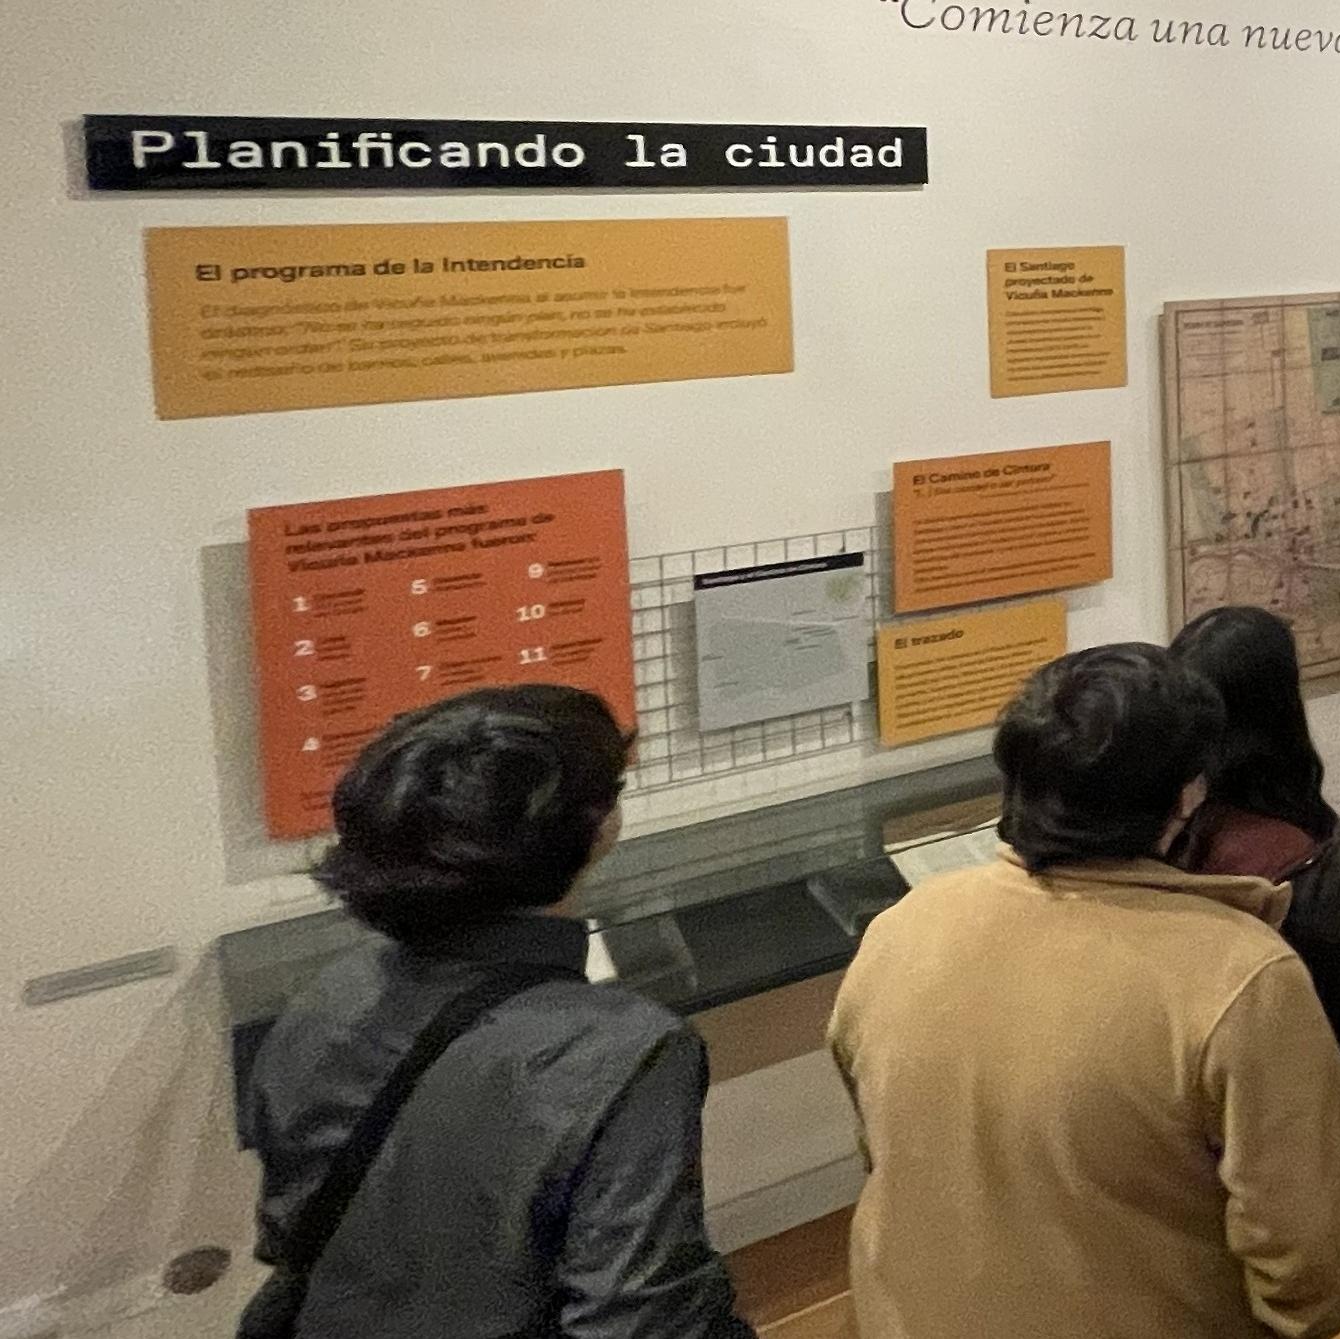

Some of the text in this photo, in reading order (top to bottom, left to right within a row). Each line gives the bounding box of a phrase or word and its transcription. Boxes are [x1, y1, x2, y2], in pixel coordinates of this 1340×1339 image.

[1151, 17, 1230, 47] una
[131, 129, 903, 169] Planificando la ciudad
[195, 253, 586, 283] El programa de la Intendencia
[1004, 261, 1075, 273] El Santiago
[1005, 272, 1094, 287] proyectado de
[1005, 288, 1114, 300] Vicuña Mackenna
[913, 475, 926, 485] El
[983, 468, 999, 479] de
[285, 523, 322, 537] Las
[326, 510, 442, 533] propuestas
[285, 511, 556, 555] relevantes del programa de
[288, 556, 358, 572] Vicuña
[364, 542, 466, 564] Mackenna
[528, 563, 544, 579] 9
[411, 578, 428, 595] 5
[292, 596, 310, 612] 1
[516, 604, 545, 622] 10
[413, 621, 431, 637] 6
[895, 629, 965, 649] El trazado
[294, 640, 315, 656] 2
[519, 647, 548, 665] 11
[416, 665, 432, 681] 7
[296, 685, 317, 701] 3
[302, 737, 320, 751] 4
